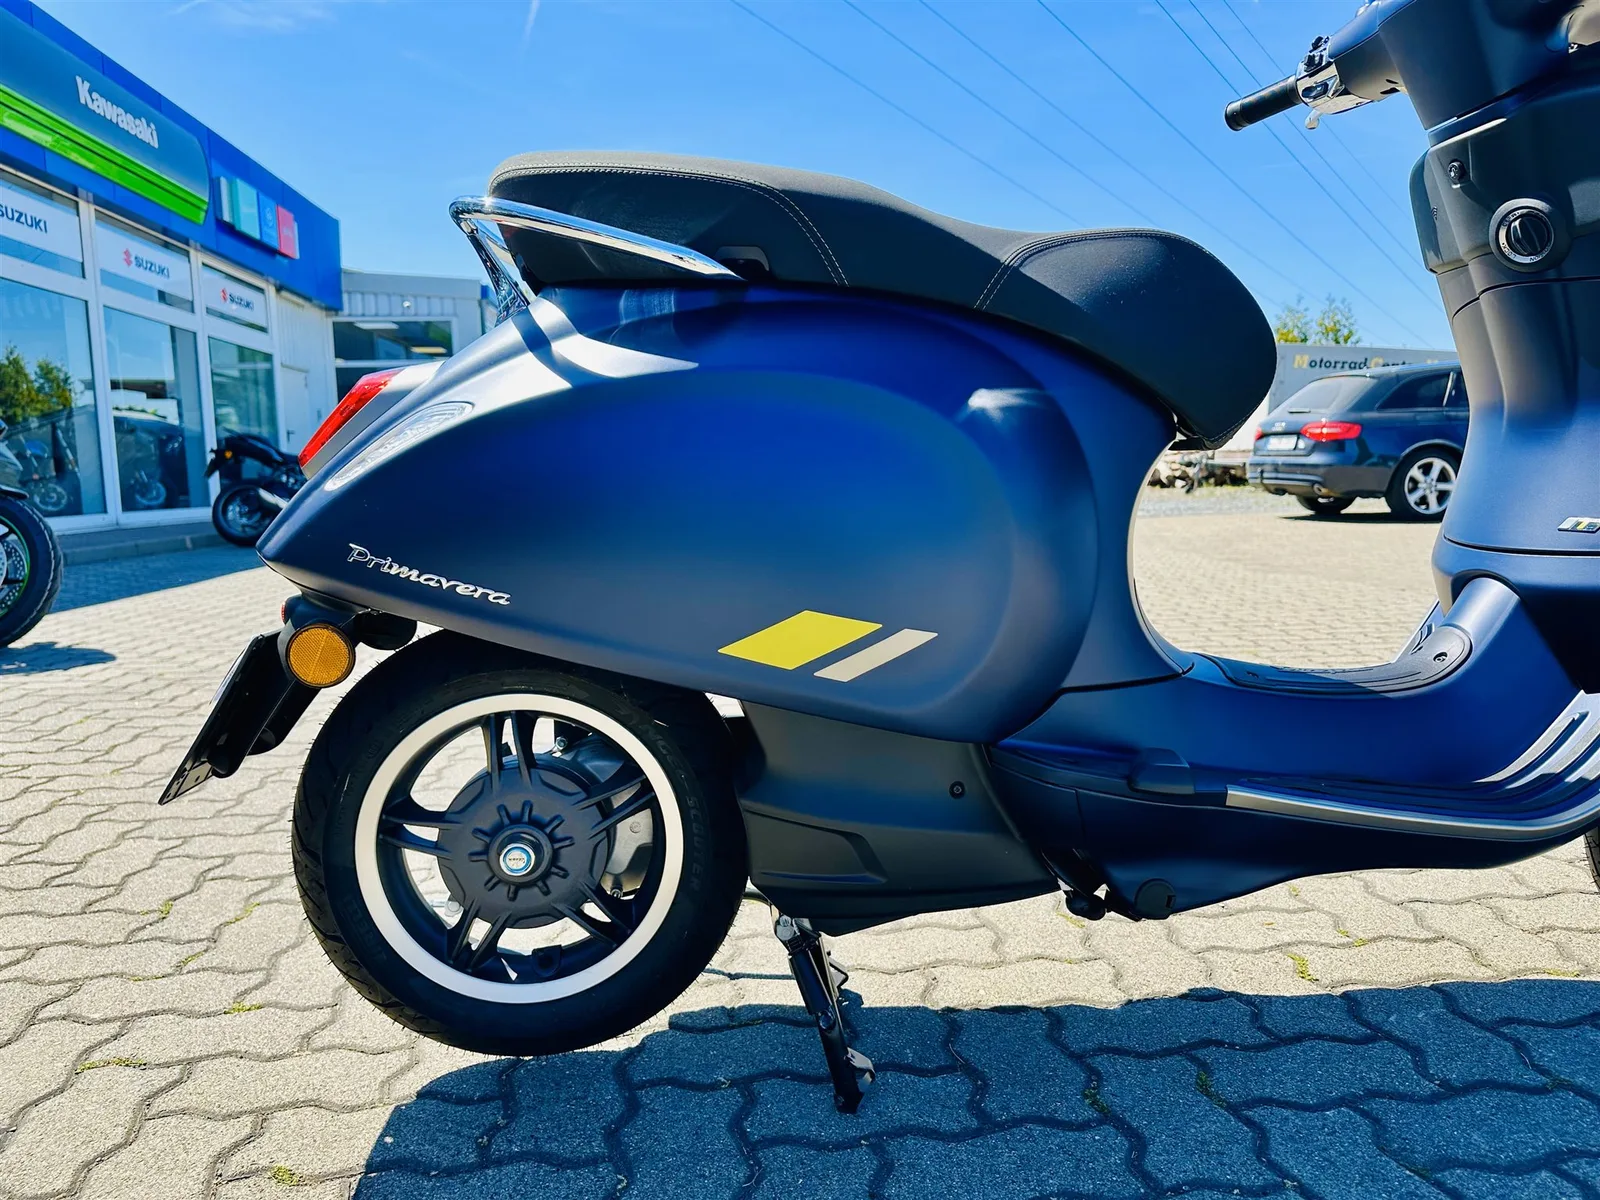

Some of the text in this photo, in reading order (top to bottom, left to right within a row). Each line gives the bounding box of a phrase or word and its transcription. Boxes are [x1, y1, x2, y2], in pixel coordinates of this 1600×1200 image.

[76, 75, 158, 148] Kawasaki
[134, 255, 170, 278] SUZUKI
[229, 293, 254, 311] SUZUKI
[1293, 354, 1368, 370] Motorrad
[347, 543, 511, 605] Primavera
